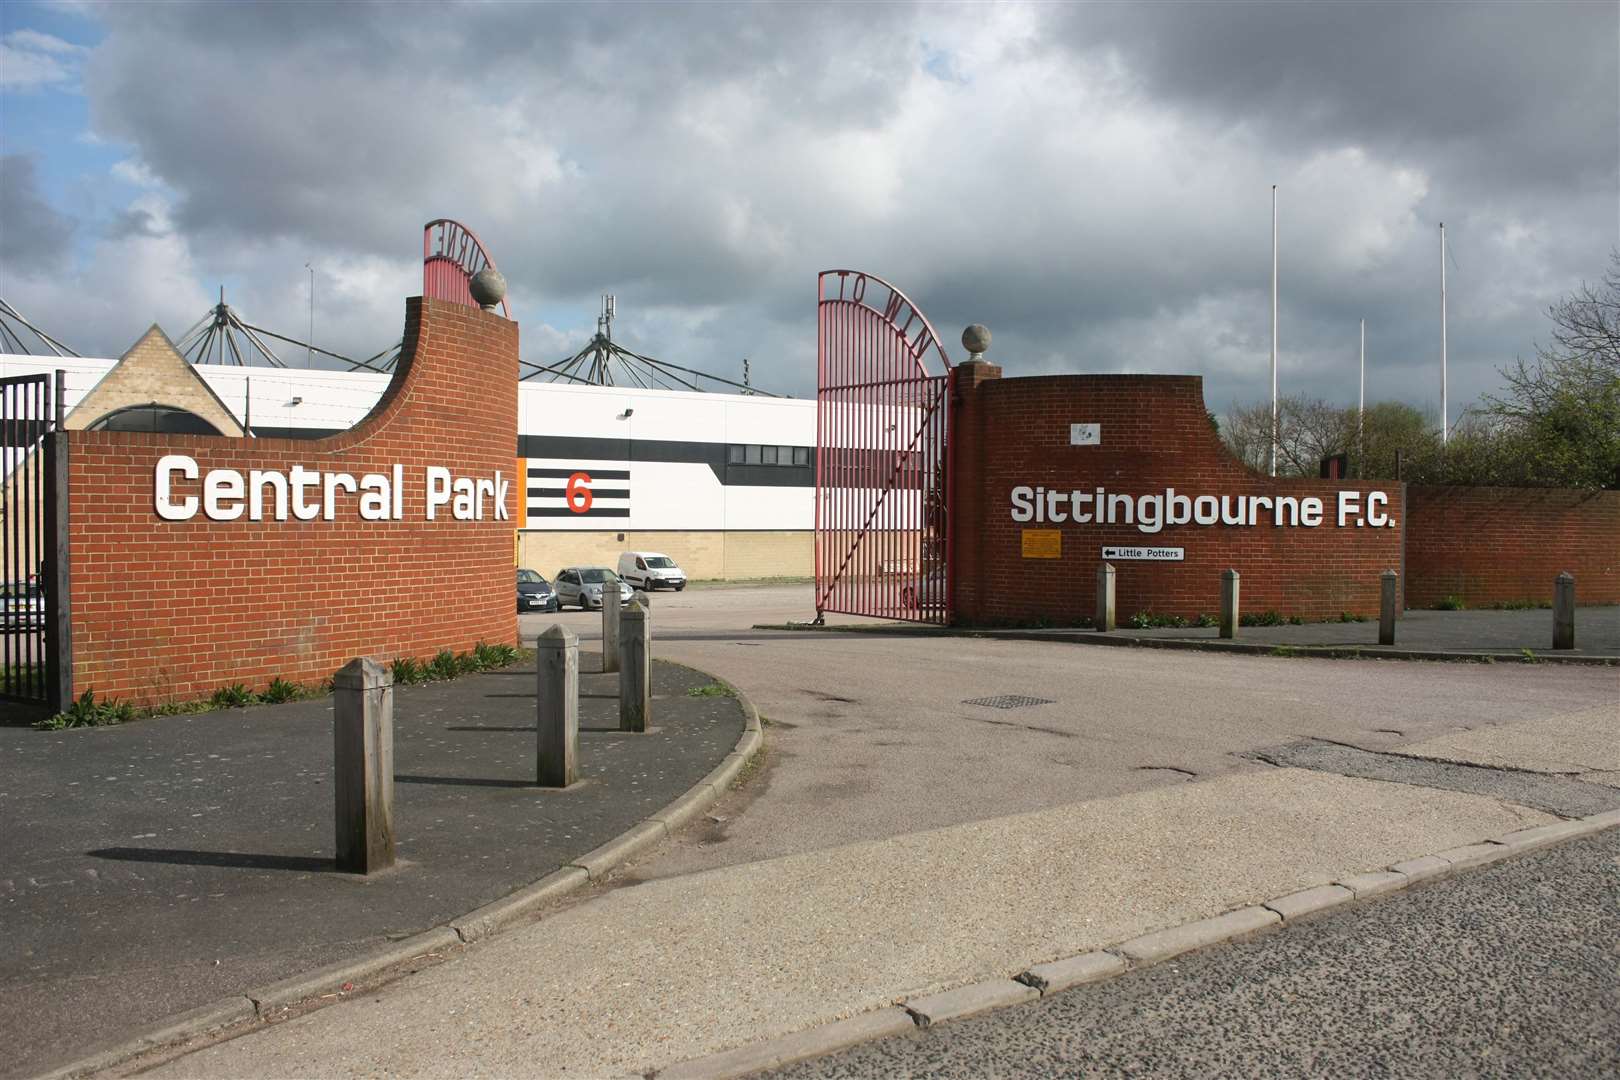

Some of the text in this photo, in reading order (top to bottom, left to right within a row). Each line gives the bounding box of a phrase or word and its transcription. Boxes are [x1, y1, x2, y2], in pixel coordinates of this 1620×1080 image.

[838, 271, 866, 303] TO
[155, 454, 510, 521] Central Park
[565, 472, 593, 514] 6
[1011, 486, 1396, 533] Sittingbourne F.C.
[1118, 548, 1179, 558] Little Potters
